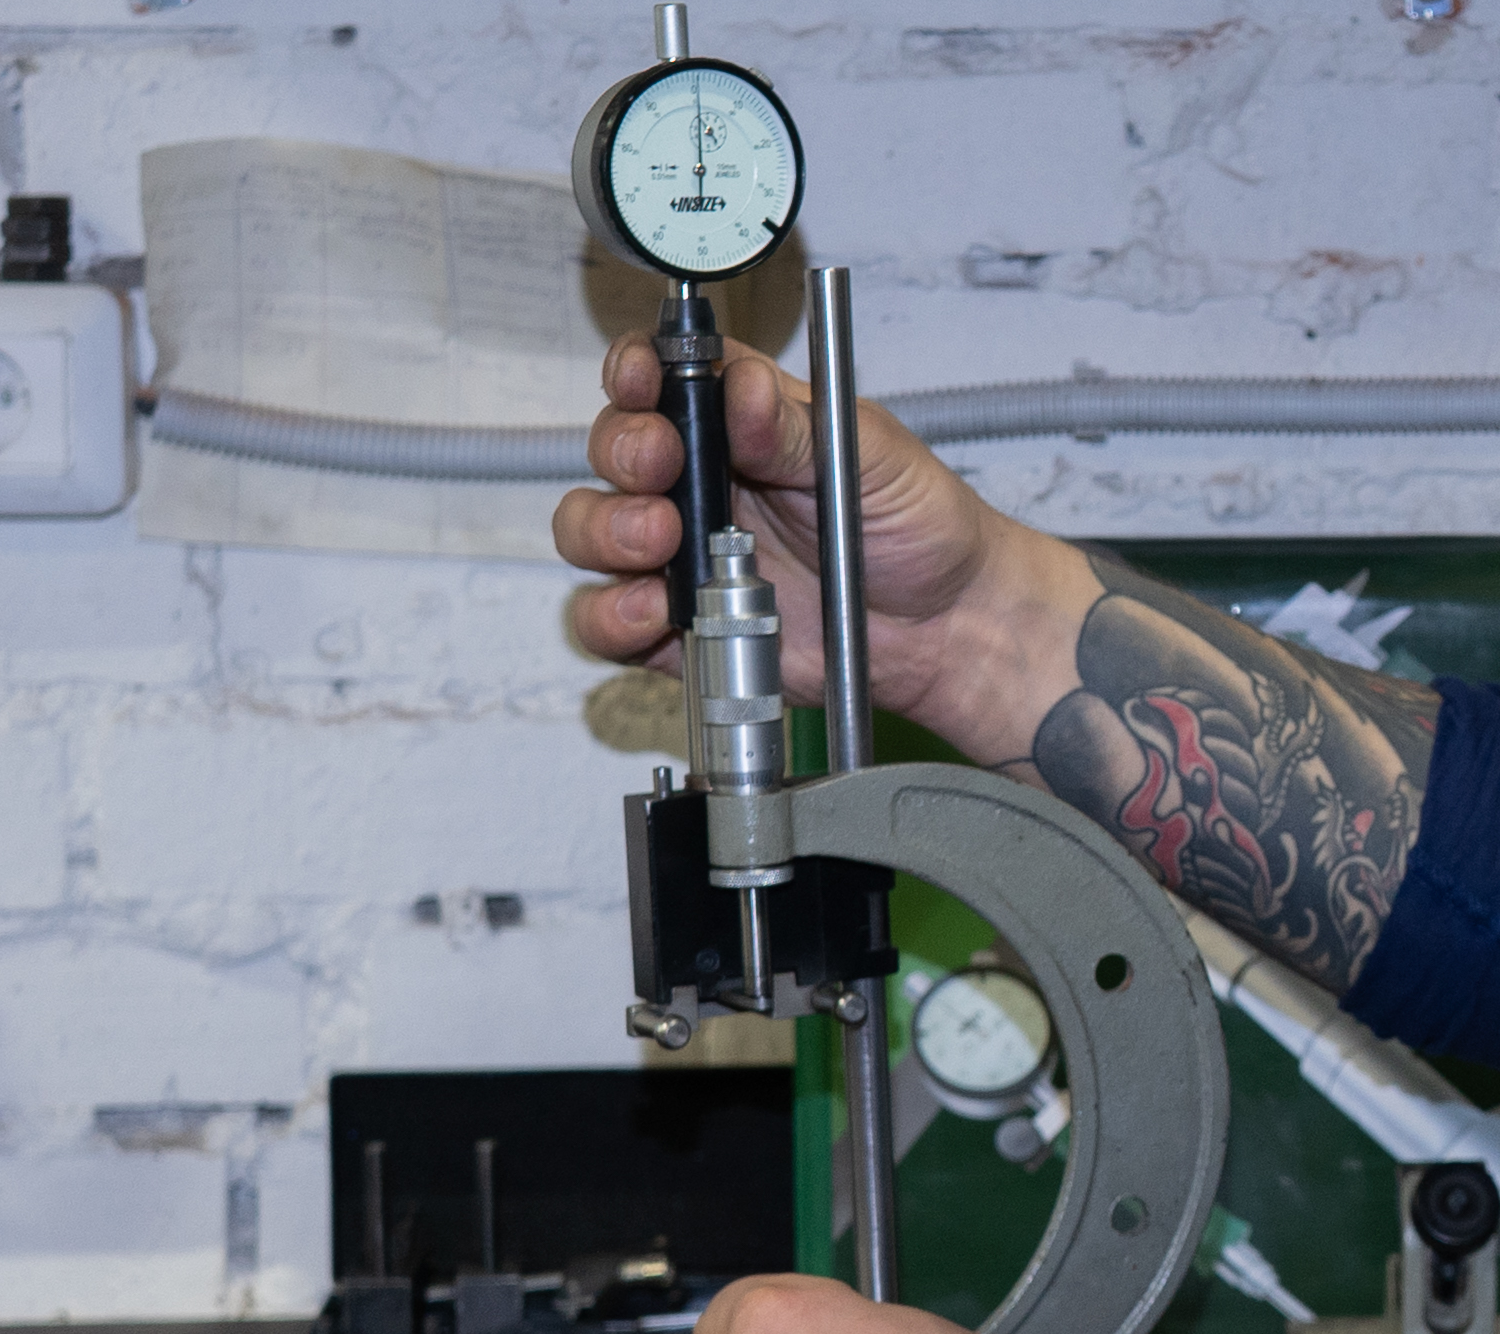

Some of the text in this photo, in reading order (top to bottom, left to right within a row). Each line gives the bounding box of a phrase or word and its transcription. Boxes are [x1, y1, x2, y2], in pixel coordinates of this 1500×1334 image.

[759, 139, 772, 149] 20
[624, 193, 636, 203] 70
[677, 196, 719, 212] INSIZE
[738, 228, 750, 238] 40
[697, 246, 708, 256] 50
